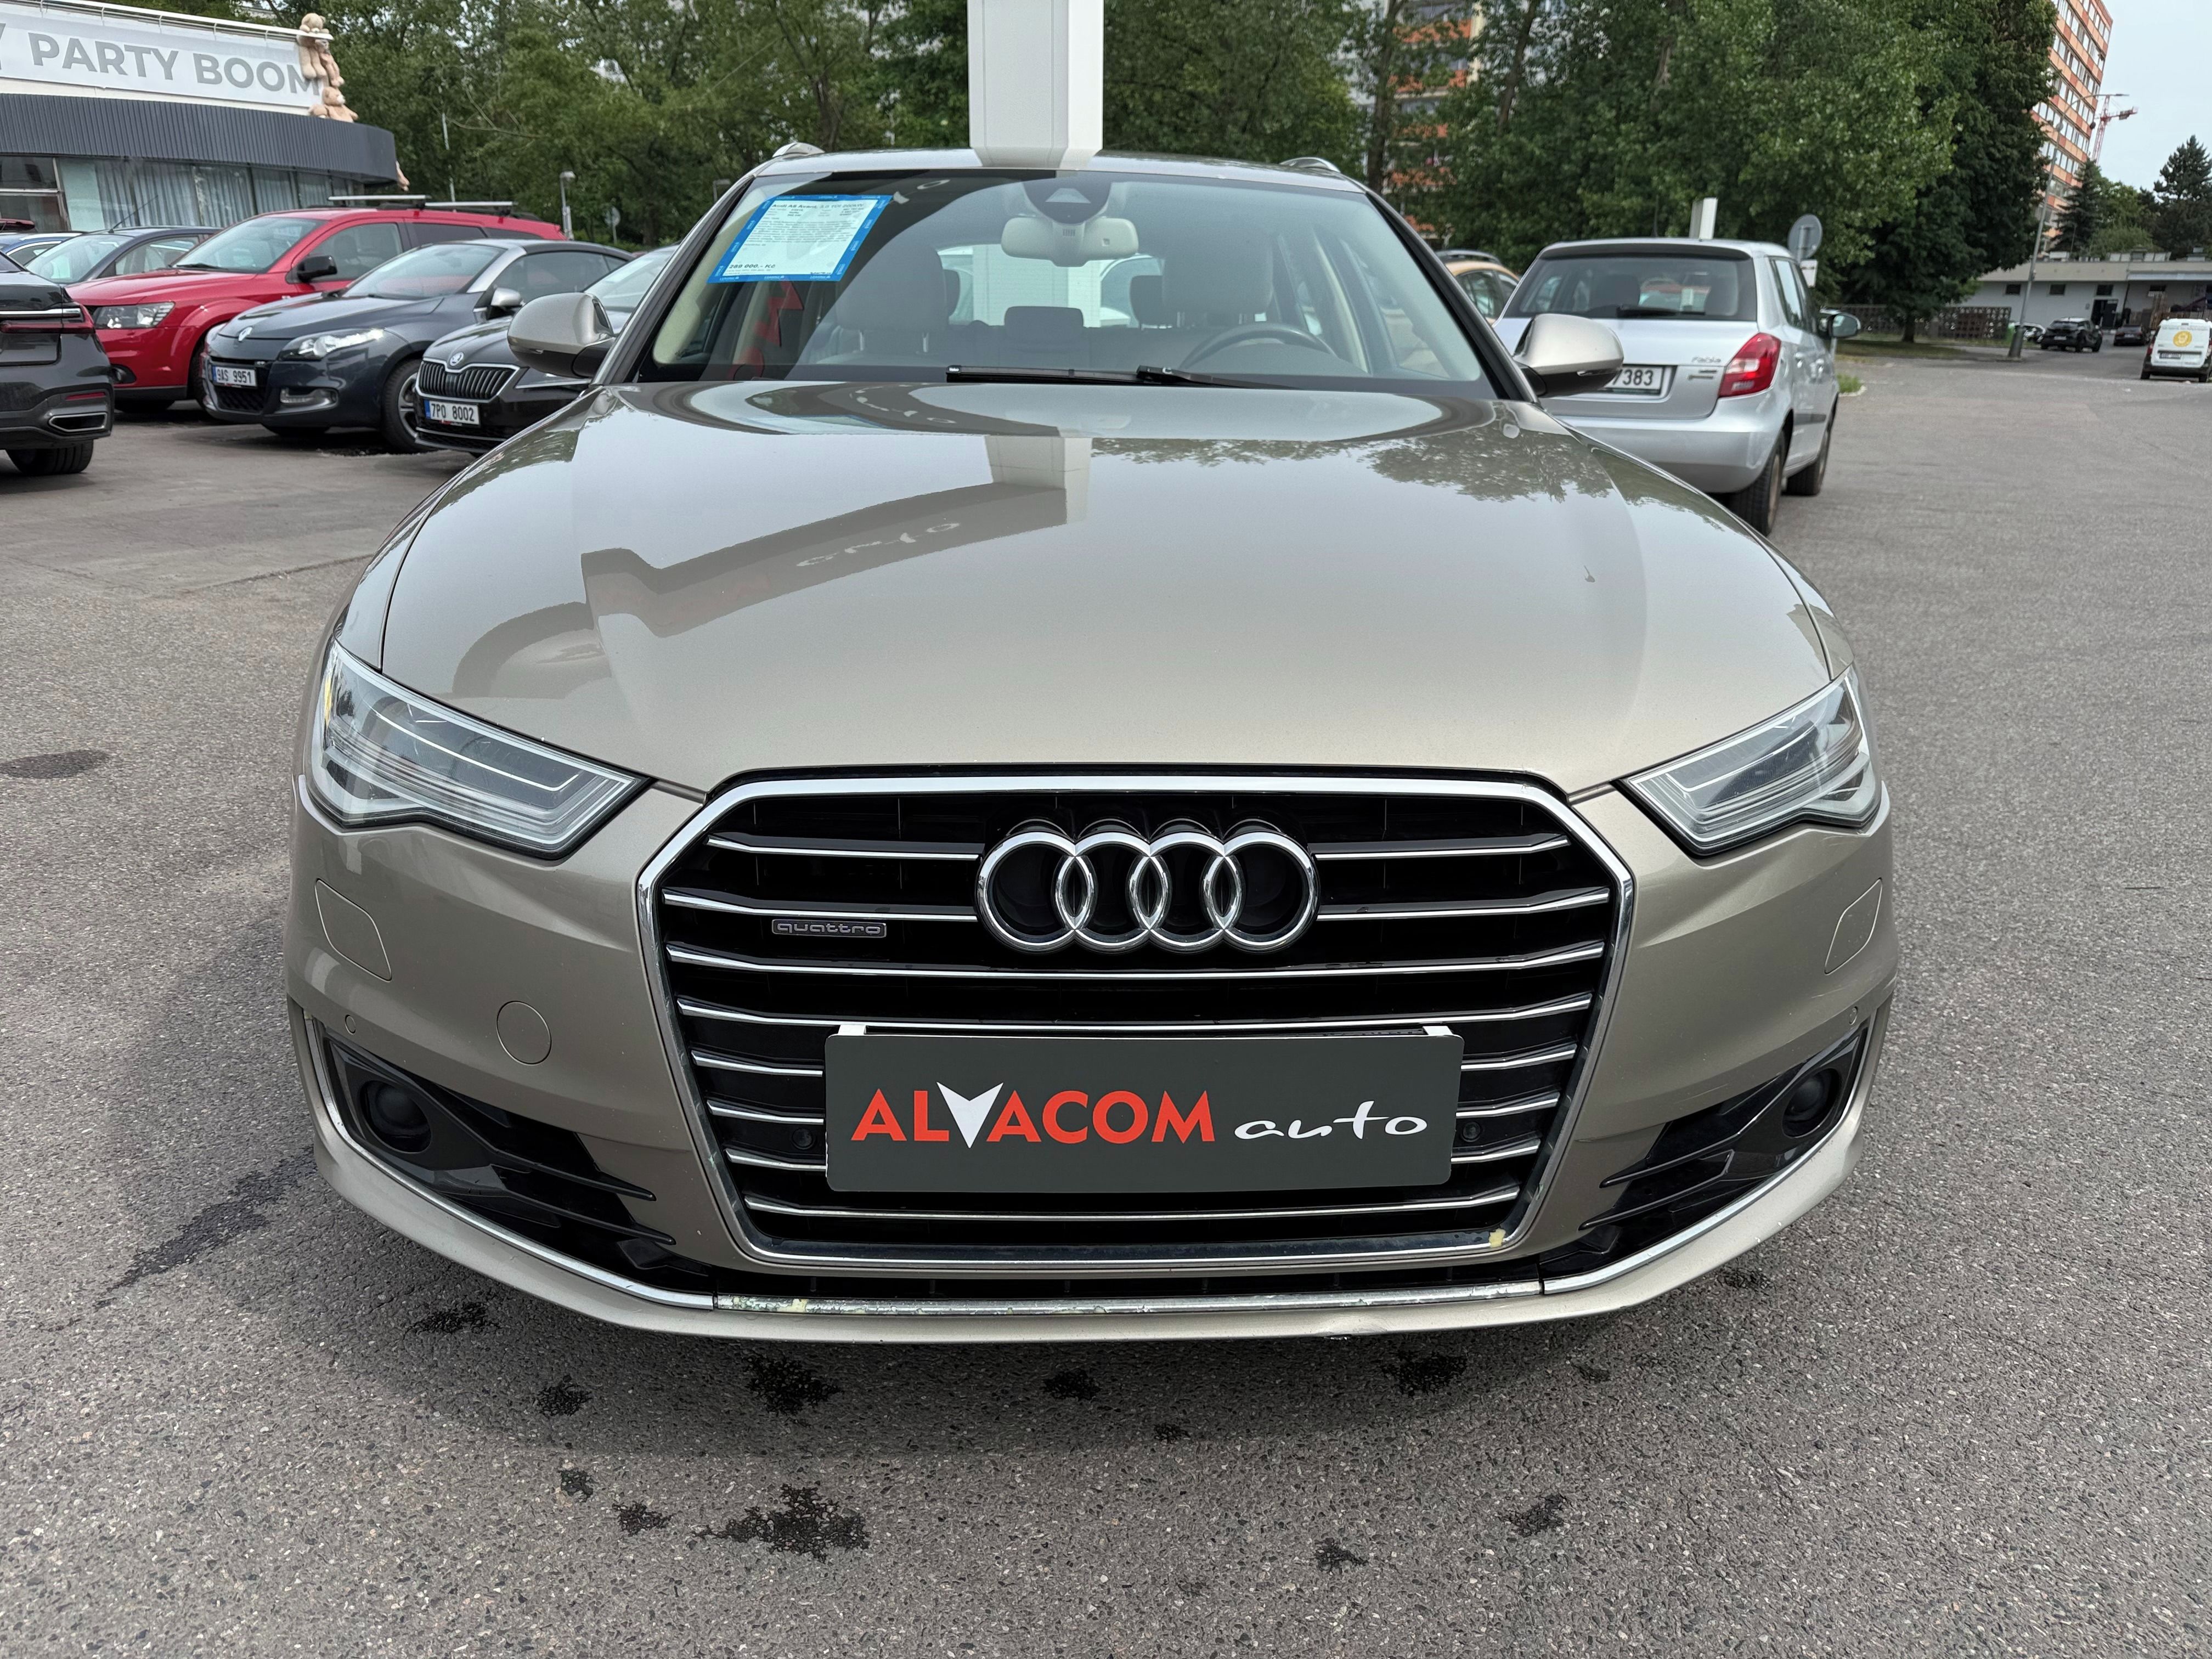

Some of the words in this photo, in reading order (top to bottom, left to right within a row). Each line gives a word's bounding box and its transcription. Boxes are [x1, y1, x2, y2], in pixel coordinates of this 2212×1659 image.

[28, 32, 179, 81] PARTY
[194, 53, 320, 96] BOOM
[217, 368, 229, 382] 9AS
[233, 370, 252, 383] 9951
[452, 405, 475, 422] 8002
[777, 923, 881, 934] quattro
[851, 1082, 1215, 1148] ALVACOM
[1234, 1101, 1427, 1139] auto
